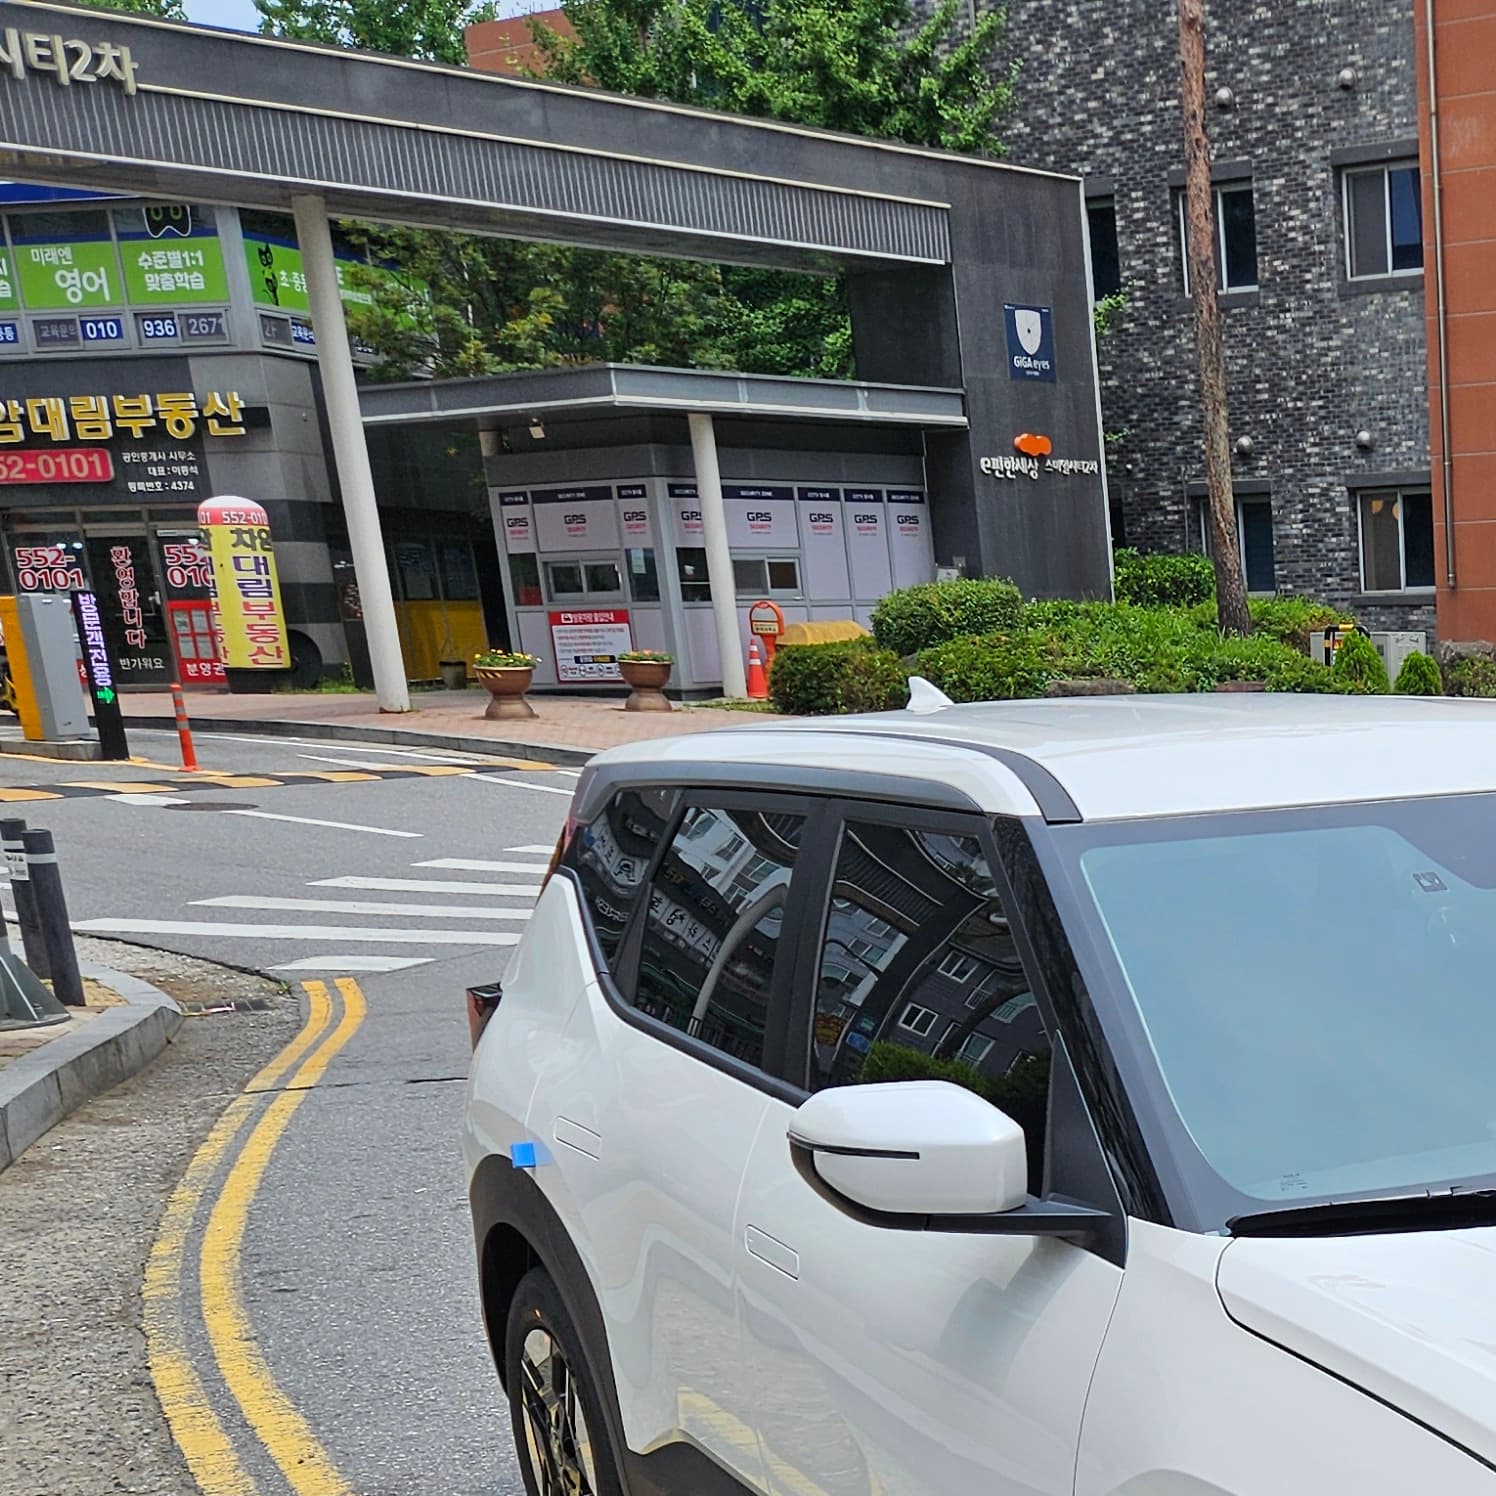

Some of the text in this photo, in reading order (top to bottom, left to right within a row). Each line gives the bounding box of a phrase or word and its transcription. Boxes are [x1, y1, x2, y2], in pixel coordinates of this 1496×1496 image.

[31, 246, 73, 266] 미래엔
[55, 266, 110, 303] 영어
[86, 321, 118, 339] 010
[144, 319, 175, 337] 936
[171, 480, 195, 490] 4374
[506, 517, 529, 528] GPS
[564, 514, 587, 525] GPS
[623, 511, 647, 522] GPS
[747, 512, 772, 522] GPS
[809, 513, 834, 523] GPS
[854, 514, 878, 524] GPS
[897, 515, 920, 525] GPS
[15, 547, 76, 568] 552-
[19, 568, 85, 590] 0101
[110, 546, 147, 649] 환영합니다
[232, 555, 284, 667] 대림부동산
[119, 657, 165, 670] 반가워요
